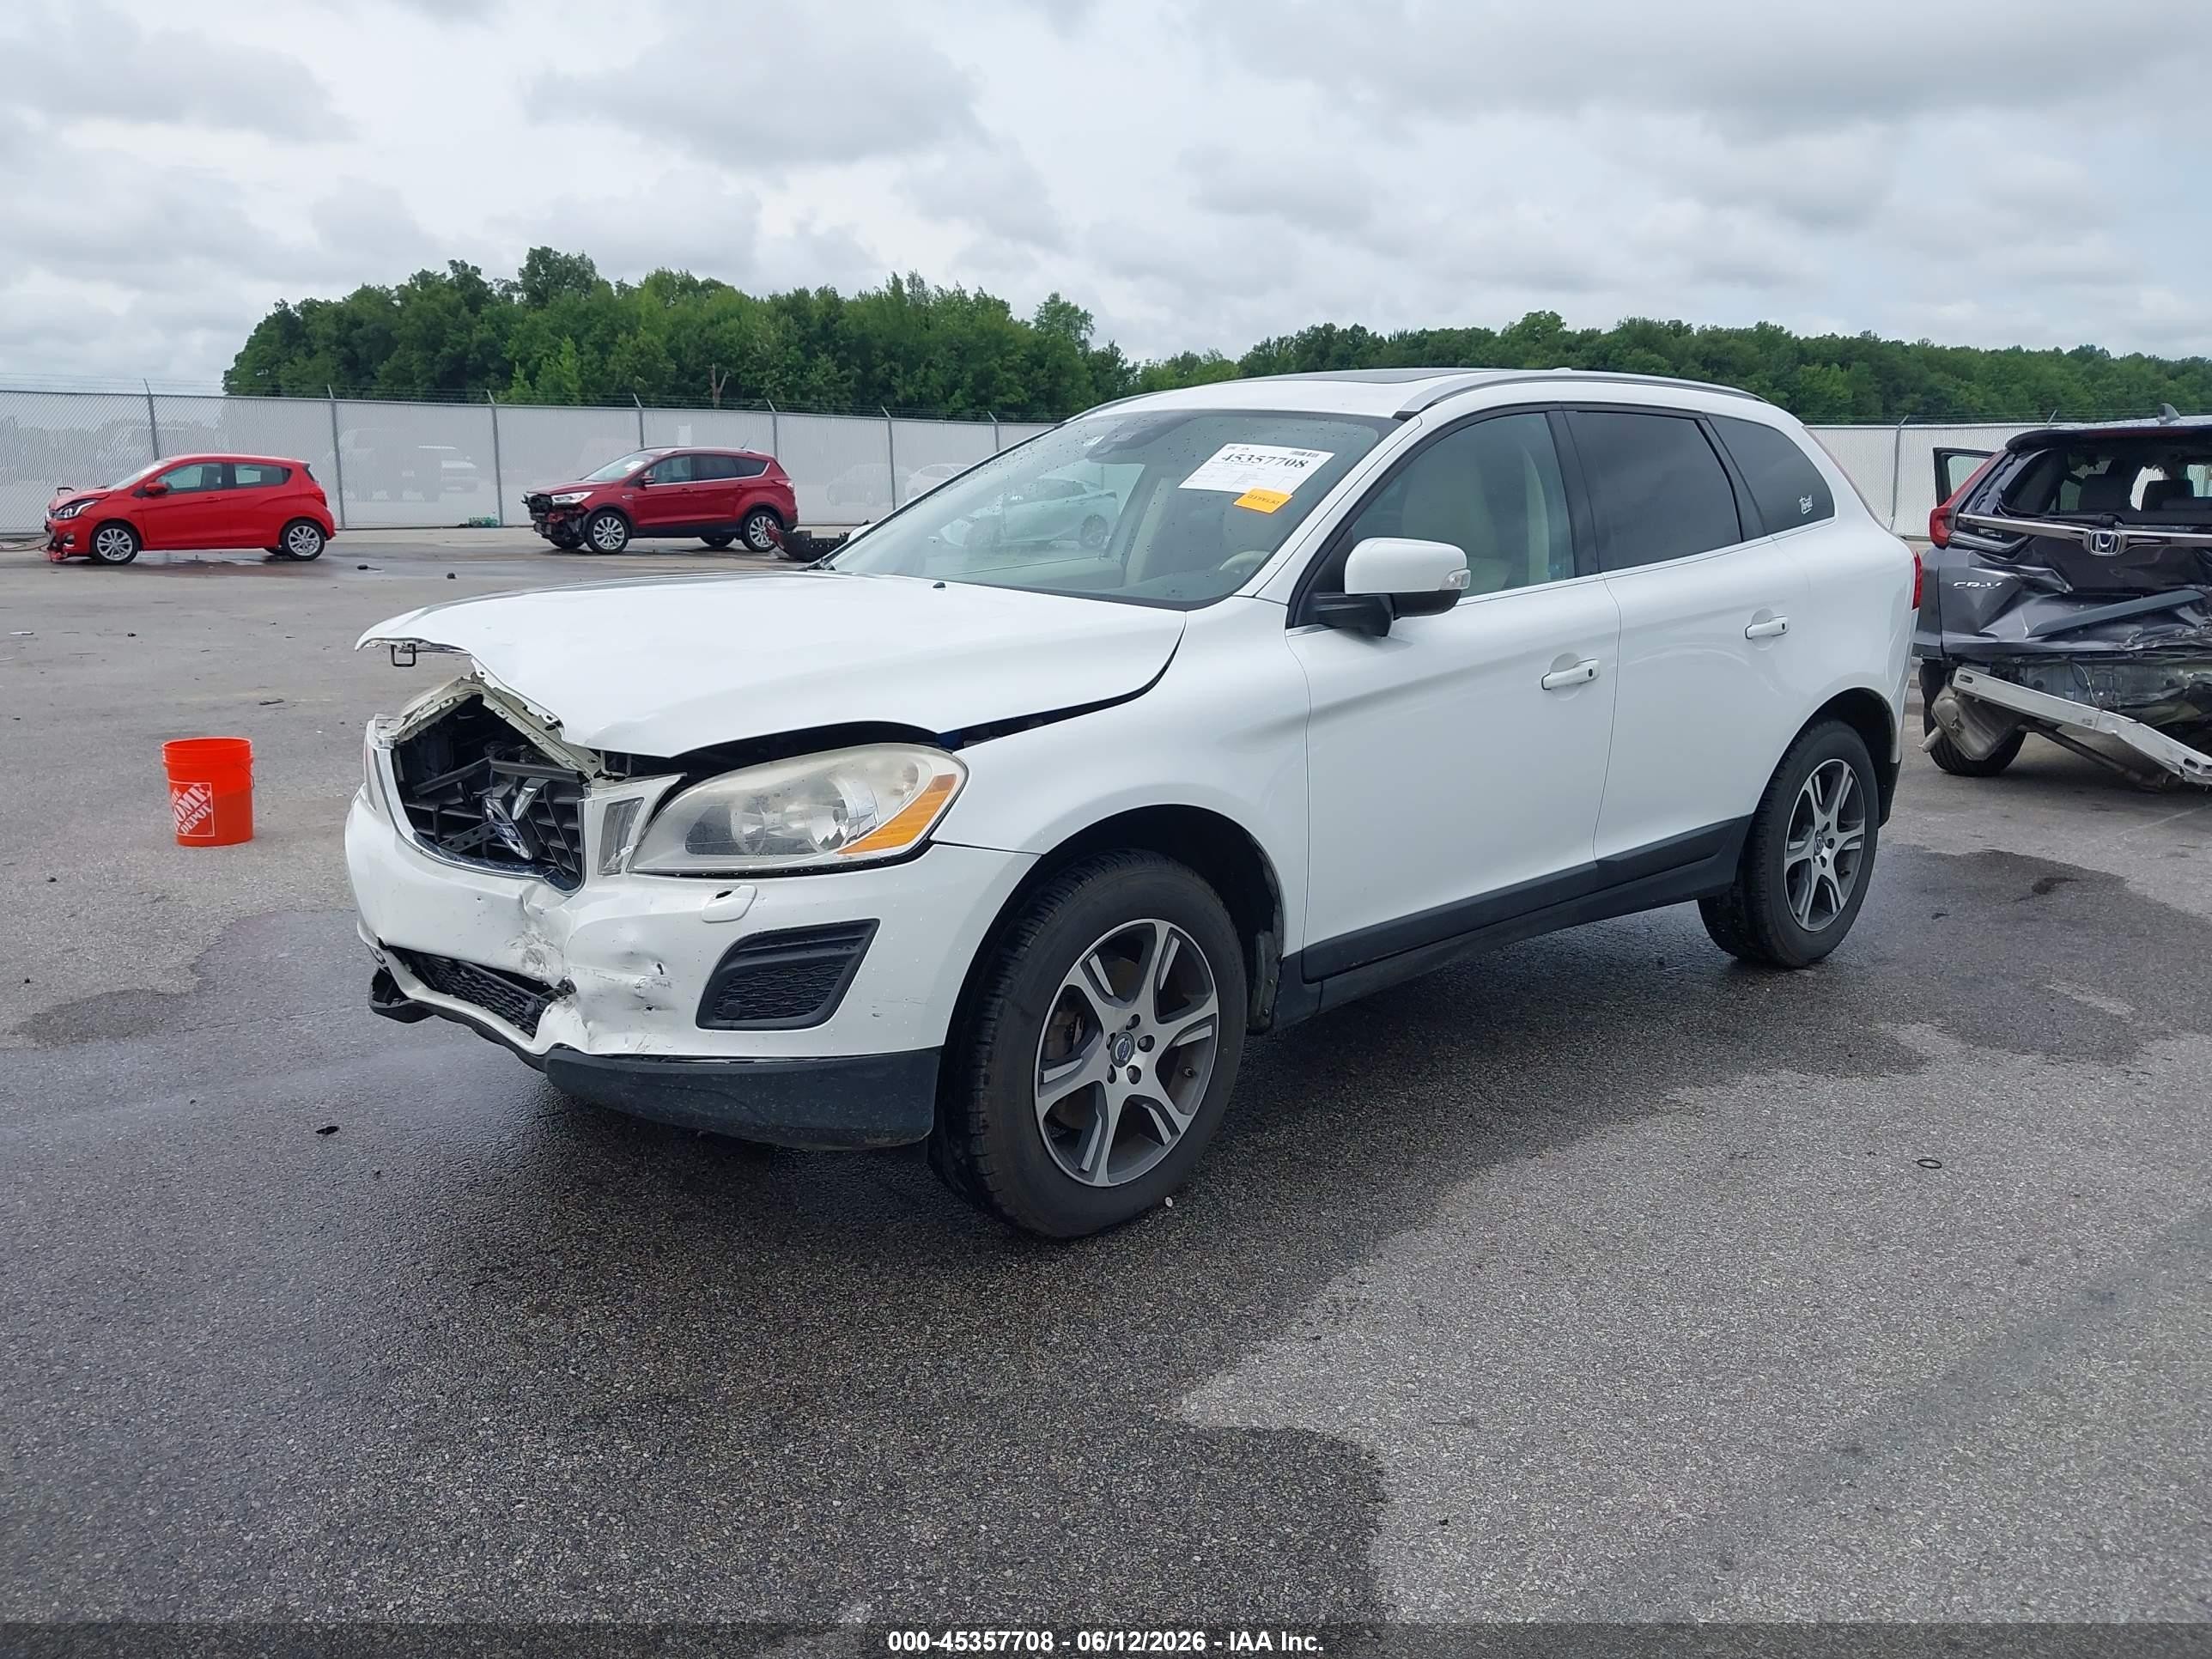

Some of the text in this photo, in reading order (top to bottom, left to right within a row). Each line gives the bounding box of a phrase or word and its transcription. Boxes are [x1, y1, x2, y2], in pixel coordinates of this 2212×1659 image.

[1221, 453, 1310, 469] 45357708
[173, 783, 212, 832] HOME
[179, 803, 212, 835] DEPOT
